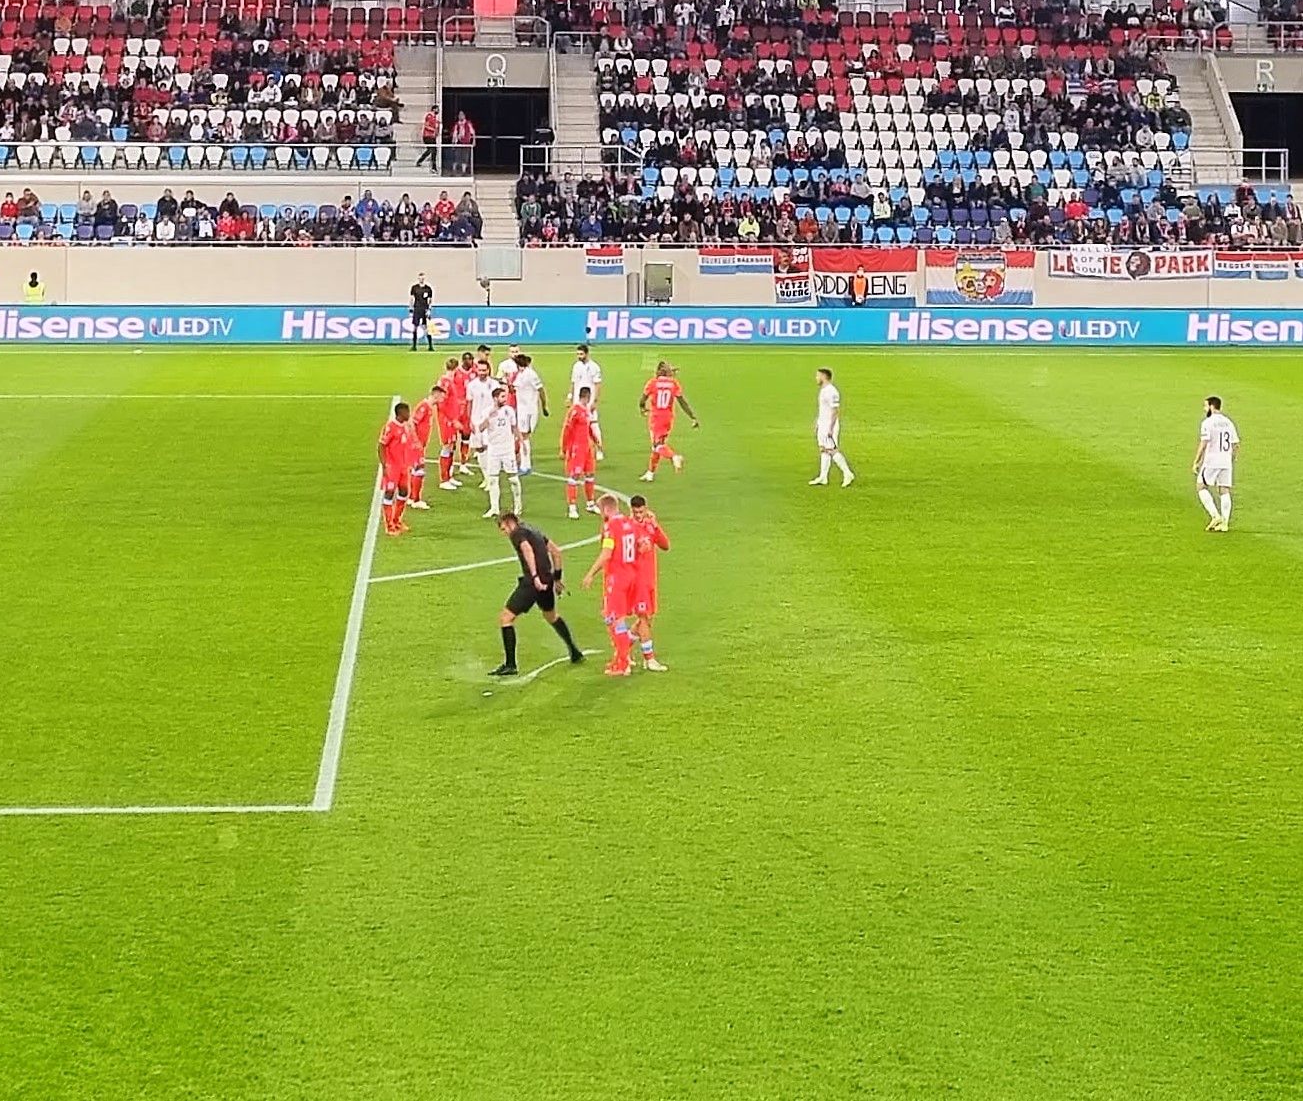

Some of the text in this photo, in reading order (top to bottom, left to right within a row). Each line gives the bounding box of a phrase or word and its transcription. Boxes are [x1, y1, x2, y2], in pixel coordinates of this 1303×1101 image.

[486, 53, 506, 77] Q
[1255, 59, 1275, 82] R
[1155, 254, 1210, 273] PARK
[587, 310, 752, 340] Hisense
[887, 311, 1053, 341] Hisense
[657, 389, 672, 410] 10
[1219, 431, 1230, 453] 13
[622, 533, 636, 563] 18
